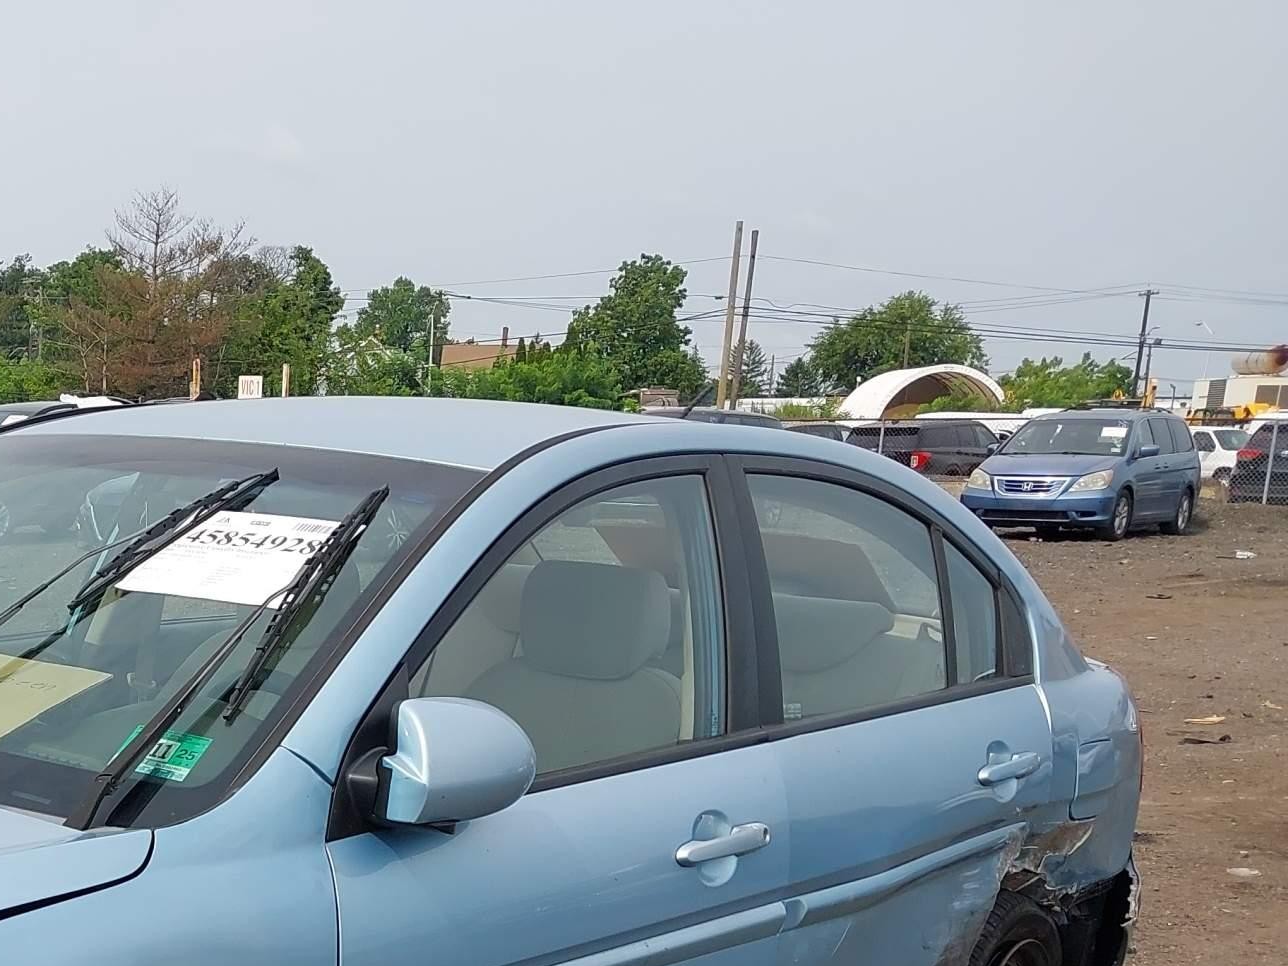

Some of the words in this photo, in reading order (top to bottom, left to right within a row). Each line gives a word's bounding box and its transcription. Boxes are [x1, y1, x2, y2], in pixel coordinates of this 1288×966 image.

[241, 379, 254, 396] VIC
[186, 528, 323, 555] 45854928
[149, 742, 173, 760] 11
[176, 748, 199, 761] 25
